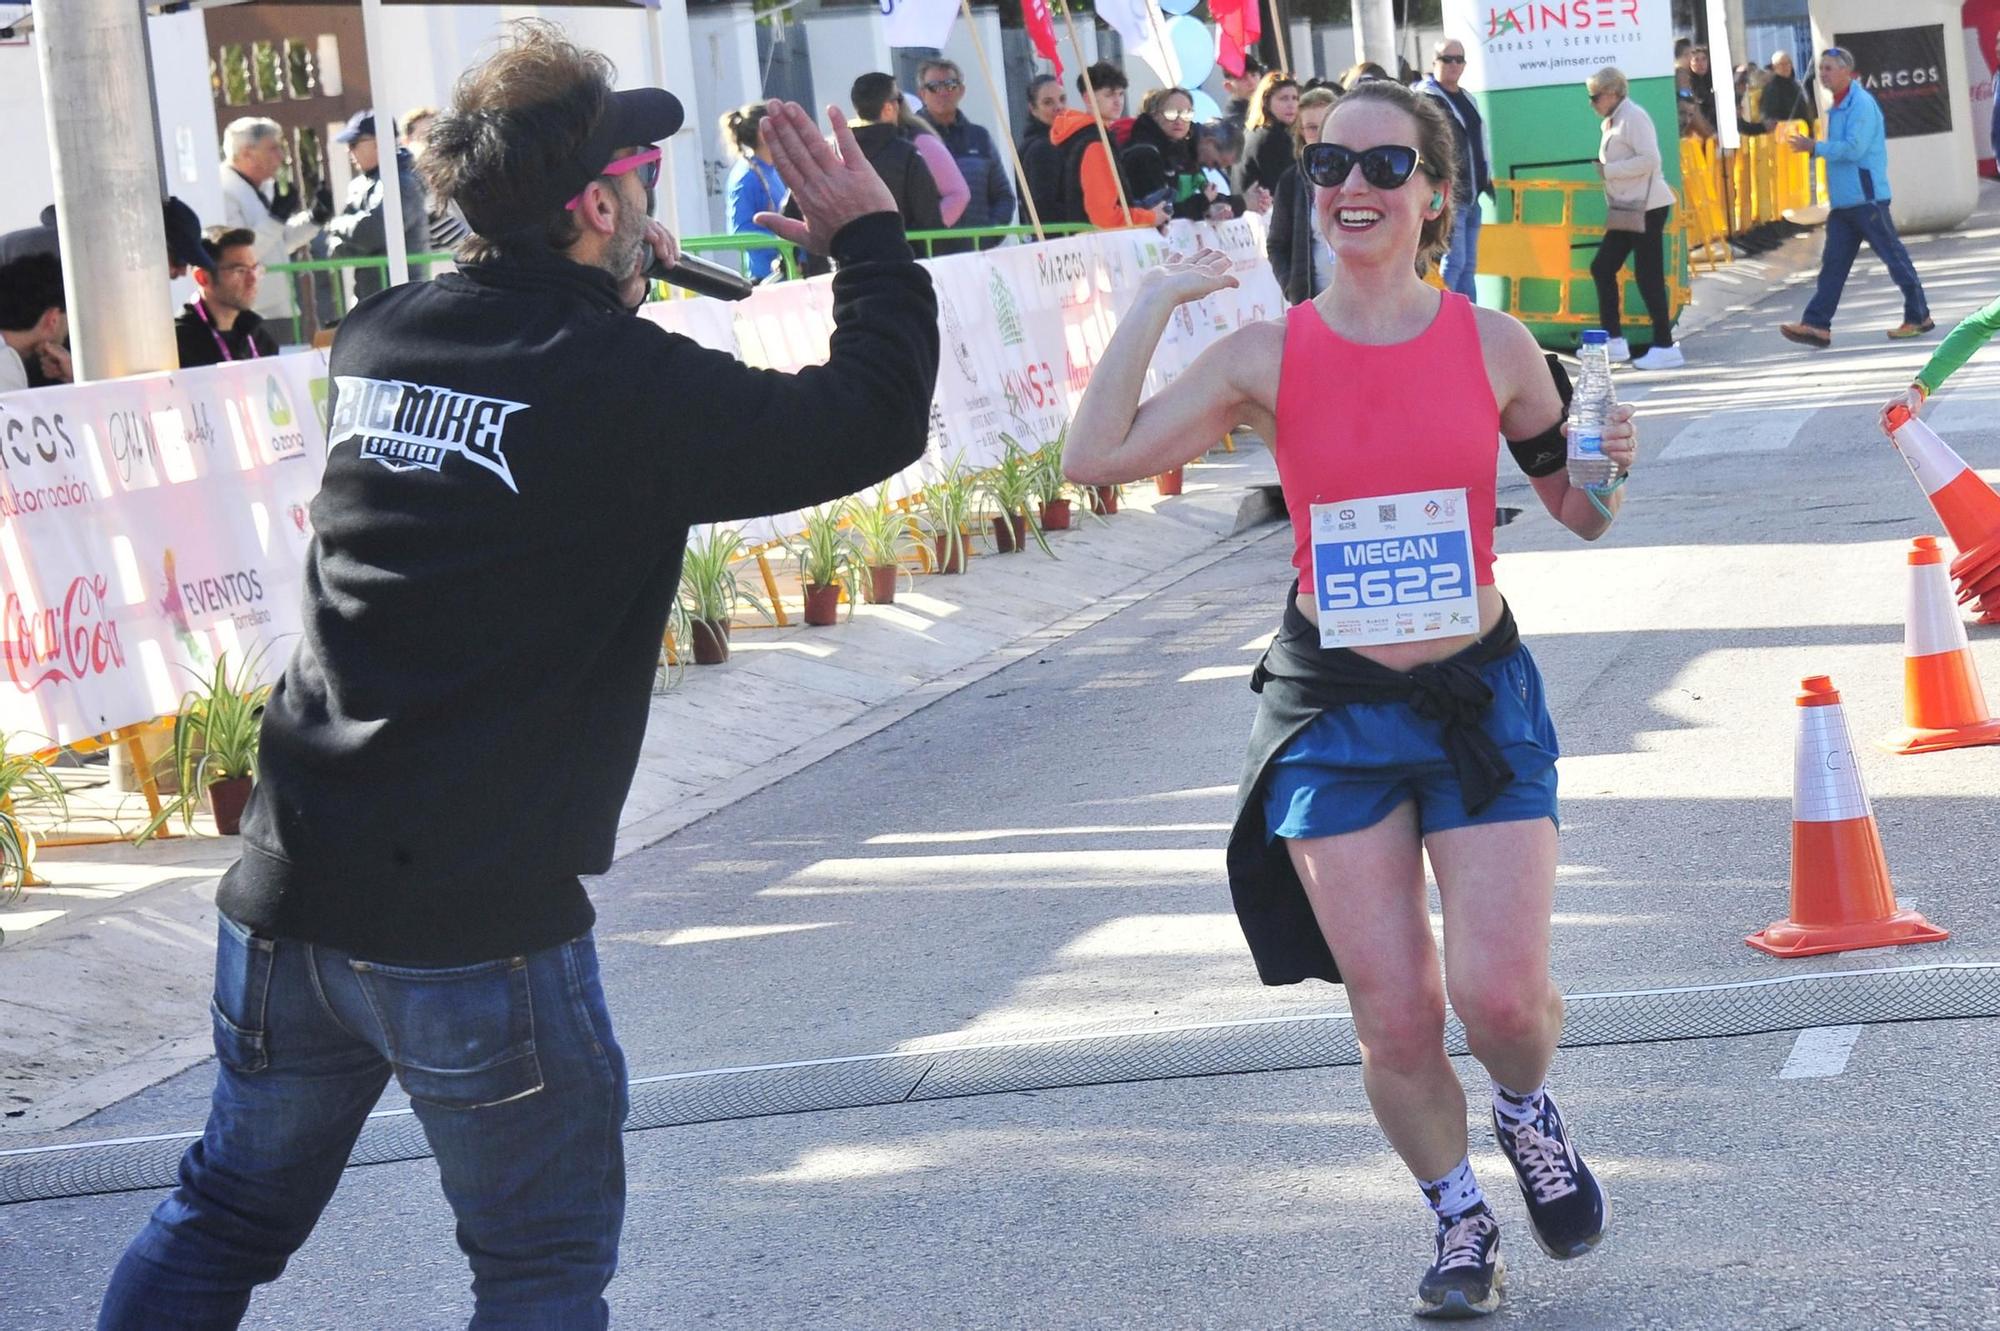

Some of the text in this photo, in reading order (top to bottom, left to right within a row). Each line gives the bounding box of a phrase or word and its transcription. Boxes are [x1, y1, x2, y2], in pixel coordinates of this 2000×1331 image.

[1488, 0, 1639, 37] JAINSER
[1488, 33, 1641, 53] OBRAS Y SERVICIOS
[1519, 55, 1616, 70] www.jainser.com
[1857, 67, 1938, 88] ARCOS
[1039, 252, 1086, 286] MARCOS
[369, 438, 437, 463] SPEAKER
[1344, 536, 1438, 567] MEGAN
[182, 568, 264, 615] EVENTOS
[1325, 563, 1463, 609] 5622
